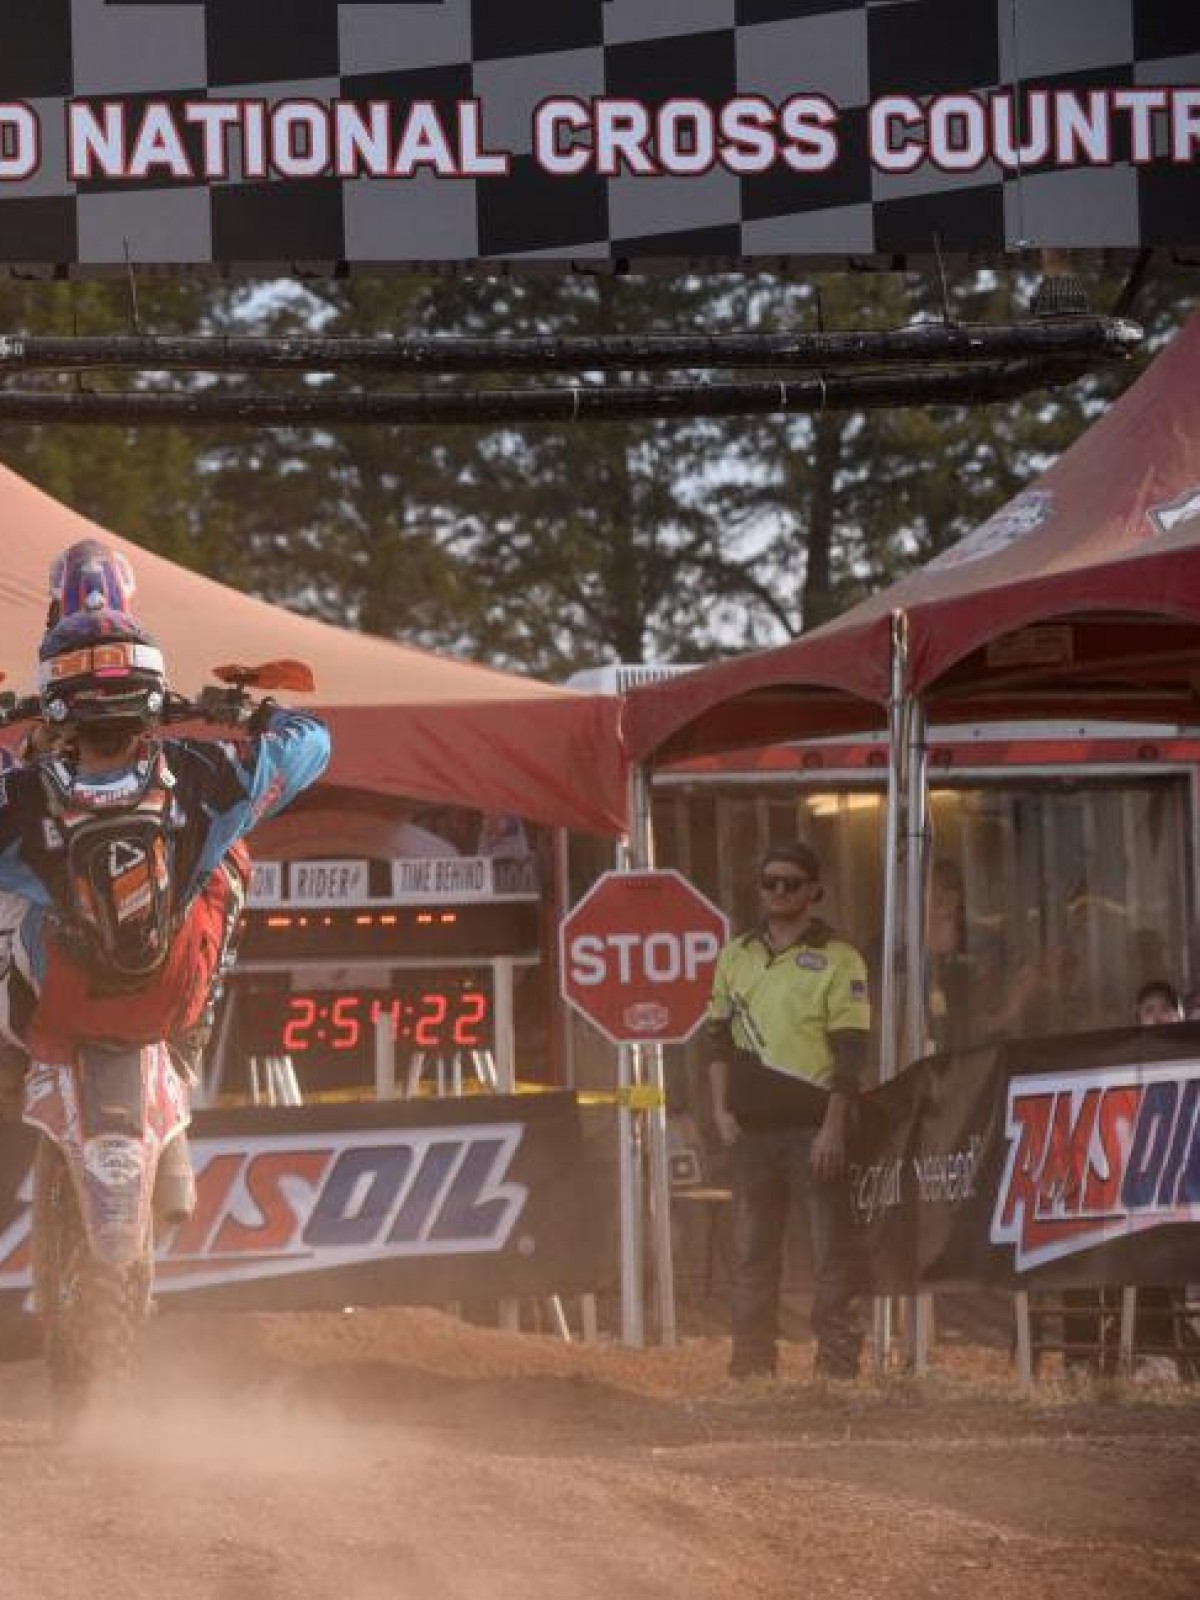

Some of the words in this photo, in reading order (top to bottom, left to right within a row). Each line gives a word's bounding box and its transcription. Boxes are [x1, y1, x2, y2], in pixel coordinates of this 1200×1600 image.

[68, 100, 509, 180] NATIONAL
[535, 95, 838, 177] CROSS
[570, 932, 720, 985] STOP
